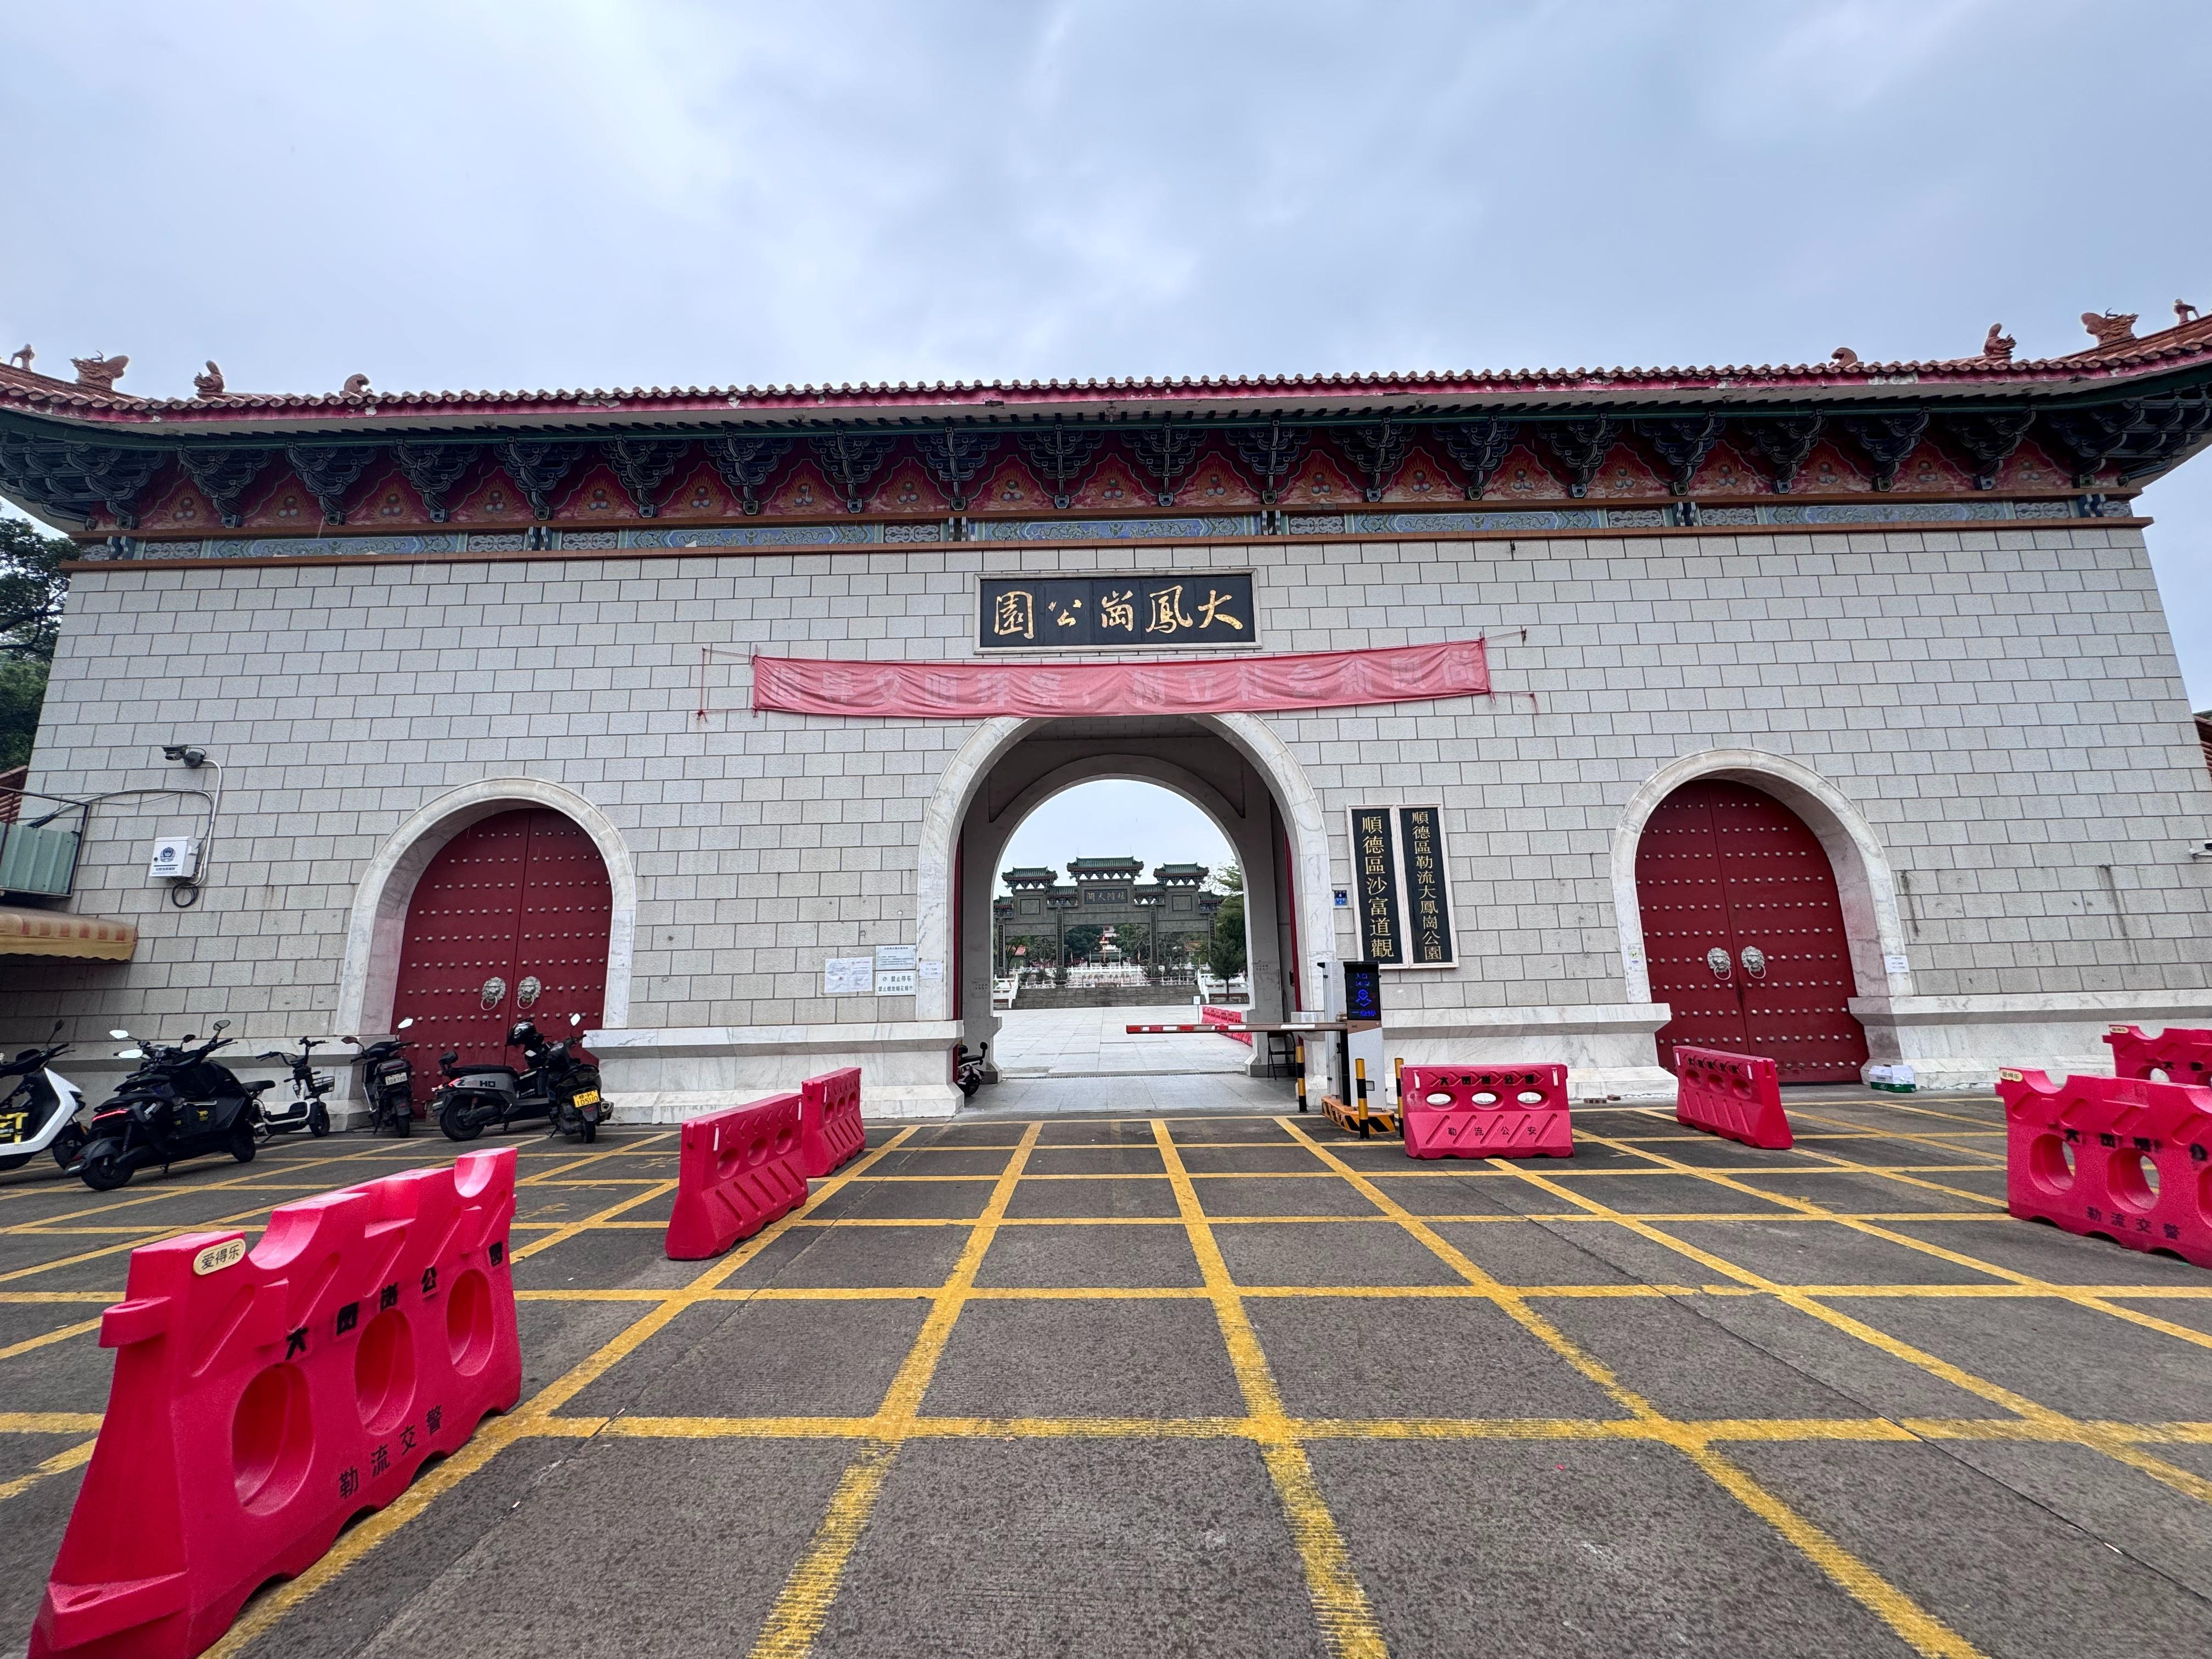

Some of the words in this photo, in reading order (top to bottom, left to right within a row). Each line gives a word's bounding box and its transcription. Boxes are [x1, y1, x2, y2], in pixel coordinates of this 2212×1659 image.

[1362, 816, 1395, 958] 順德區沙富道觀
[1448, 1126, 1537, 1136] 勒流公安
[2087, 1205, 2180, 1240] 勒流交警
[201, 1244, 240, 1270] 爱得乐
[338, 1404, 443, 1499] 勒流交警
